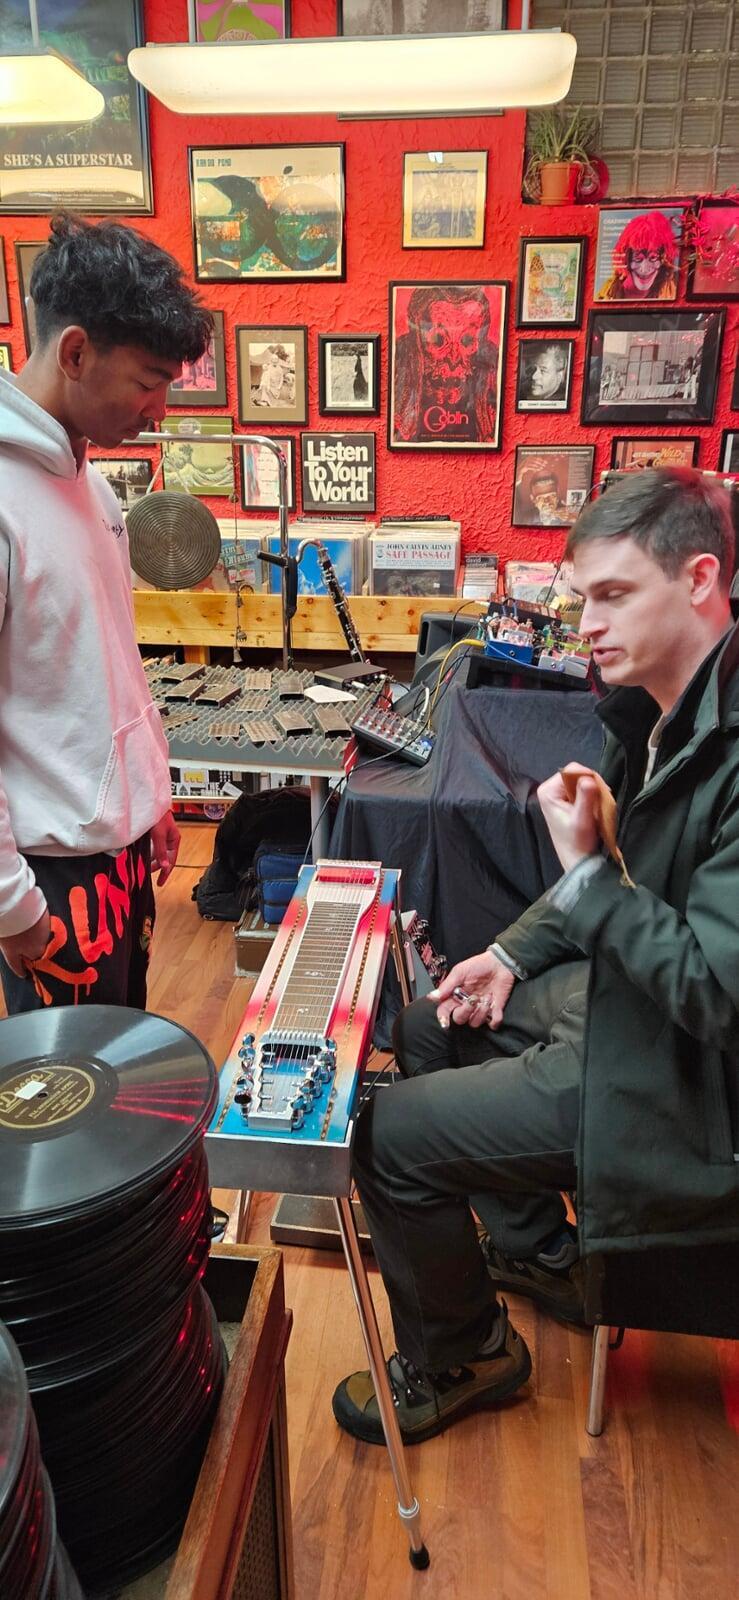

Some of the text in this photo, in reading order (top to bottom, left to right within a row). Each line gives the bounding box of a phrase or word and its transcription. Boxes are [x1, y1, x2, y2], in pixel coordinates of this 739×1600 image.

[4, 153, 133, 167] SHE'S A SUPERSTAR
[423, 405, 469, 433] Goblin
[307, 440, 369, 462] Listen
[303, 460, 328, 482] To
[327, 460, 373, 482] Your
[308, 480, 369, 503] World
[385, 550, 451, 560] SAFE PASSAGE
[386, 543, 405, 551] JOHN
[406, 543, 430, 551] CALVIN
